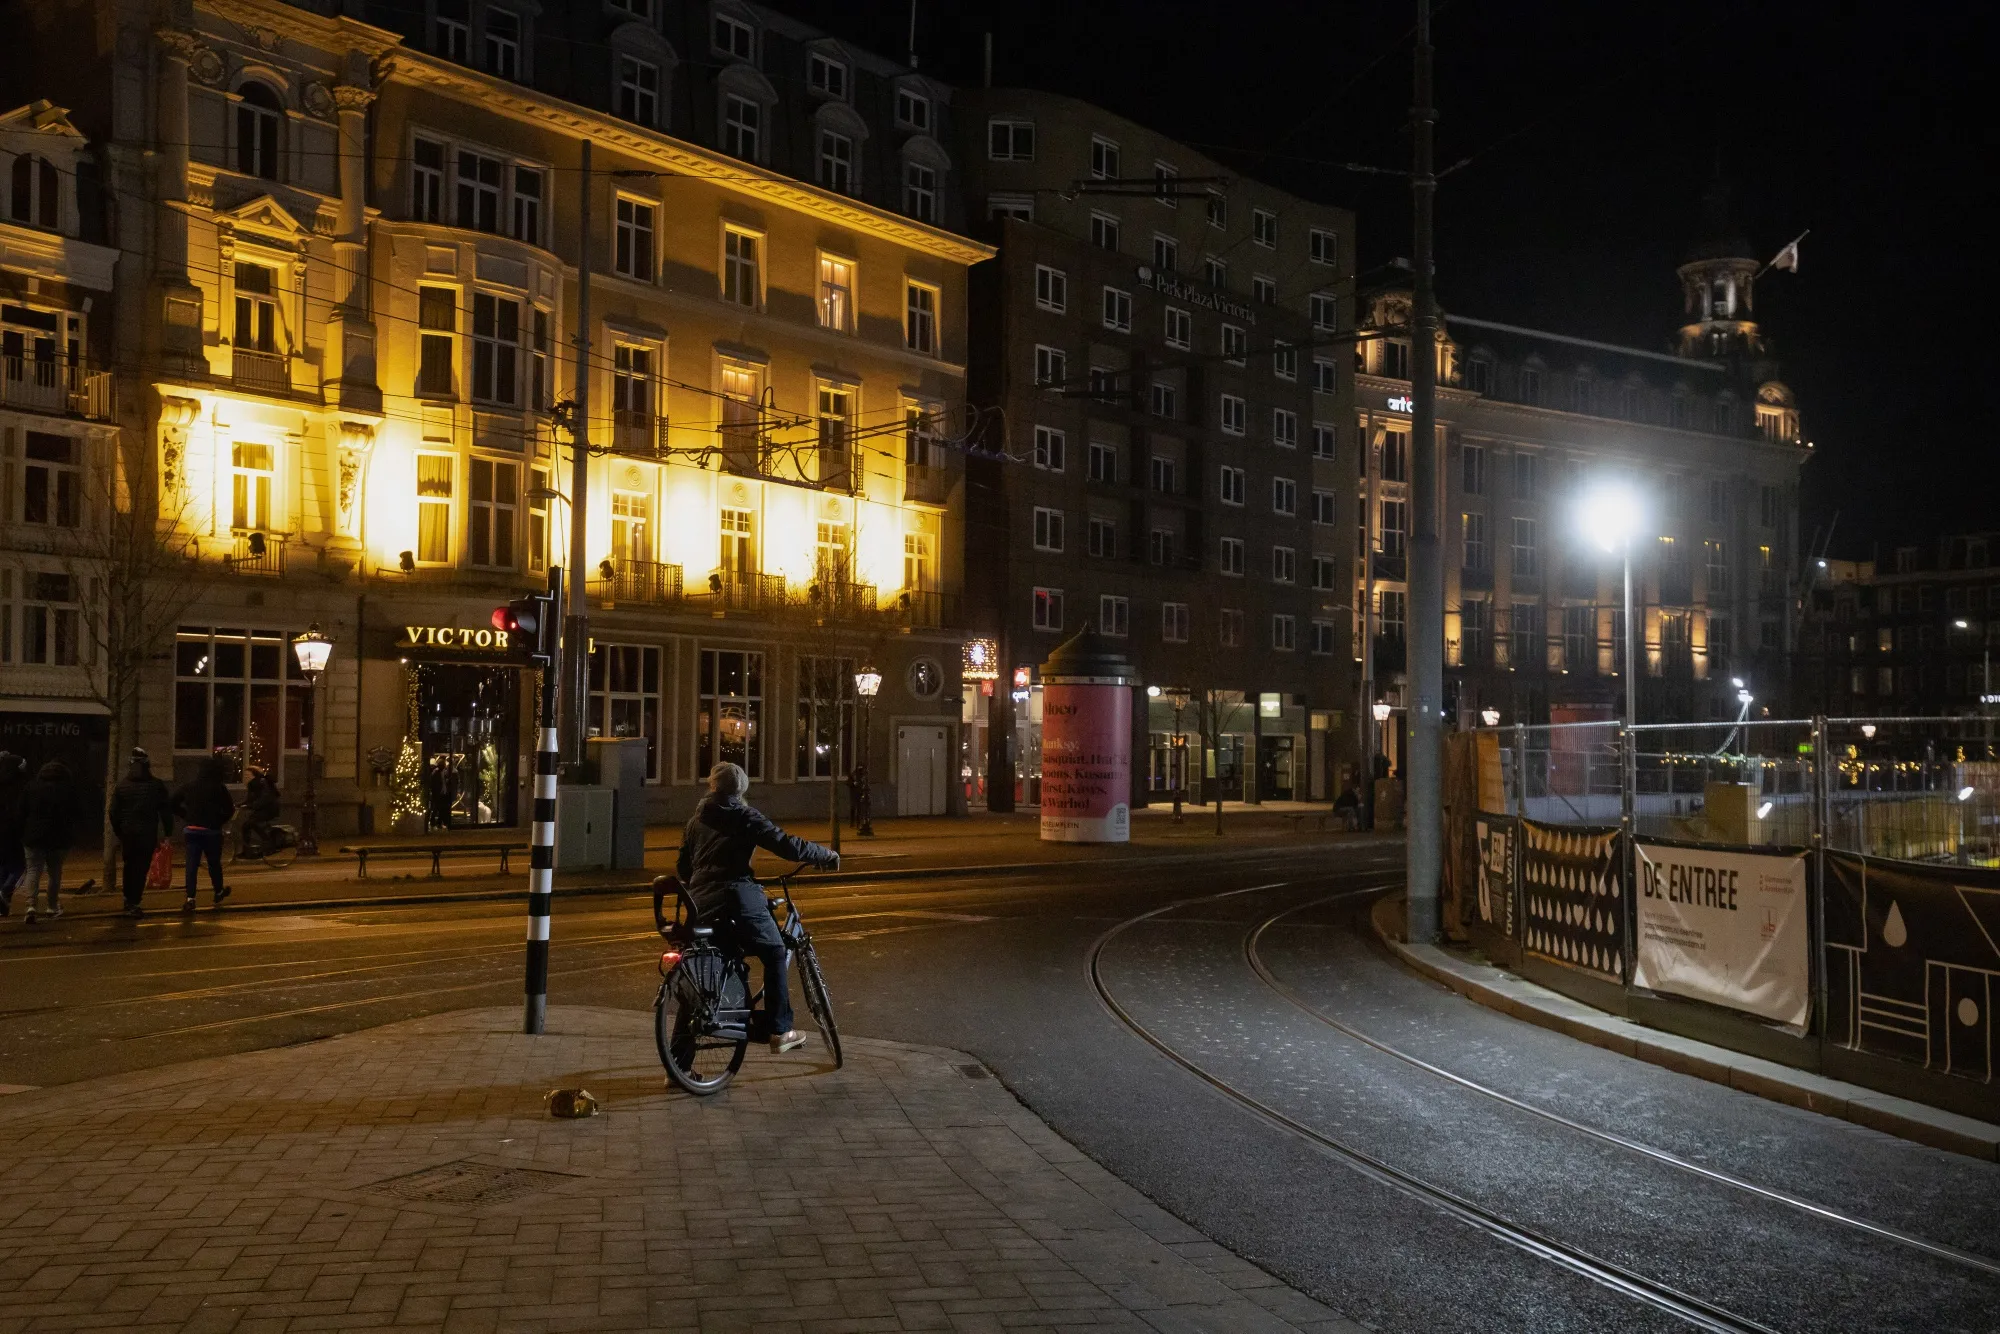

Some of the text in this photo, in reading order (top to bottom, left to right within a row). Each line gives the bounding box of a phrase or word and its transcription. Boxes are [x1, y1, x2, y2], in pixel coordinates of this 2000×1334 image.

[1156, 273, 1257, 326] Park Plaza Victoria
[0, 722, 81, 736] HTSEEING
[1643, 861, 1739, 911] DE ENTREE
[1505, 891, 1513, 936] OVER
